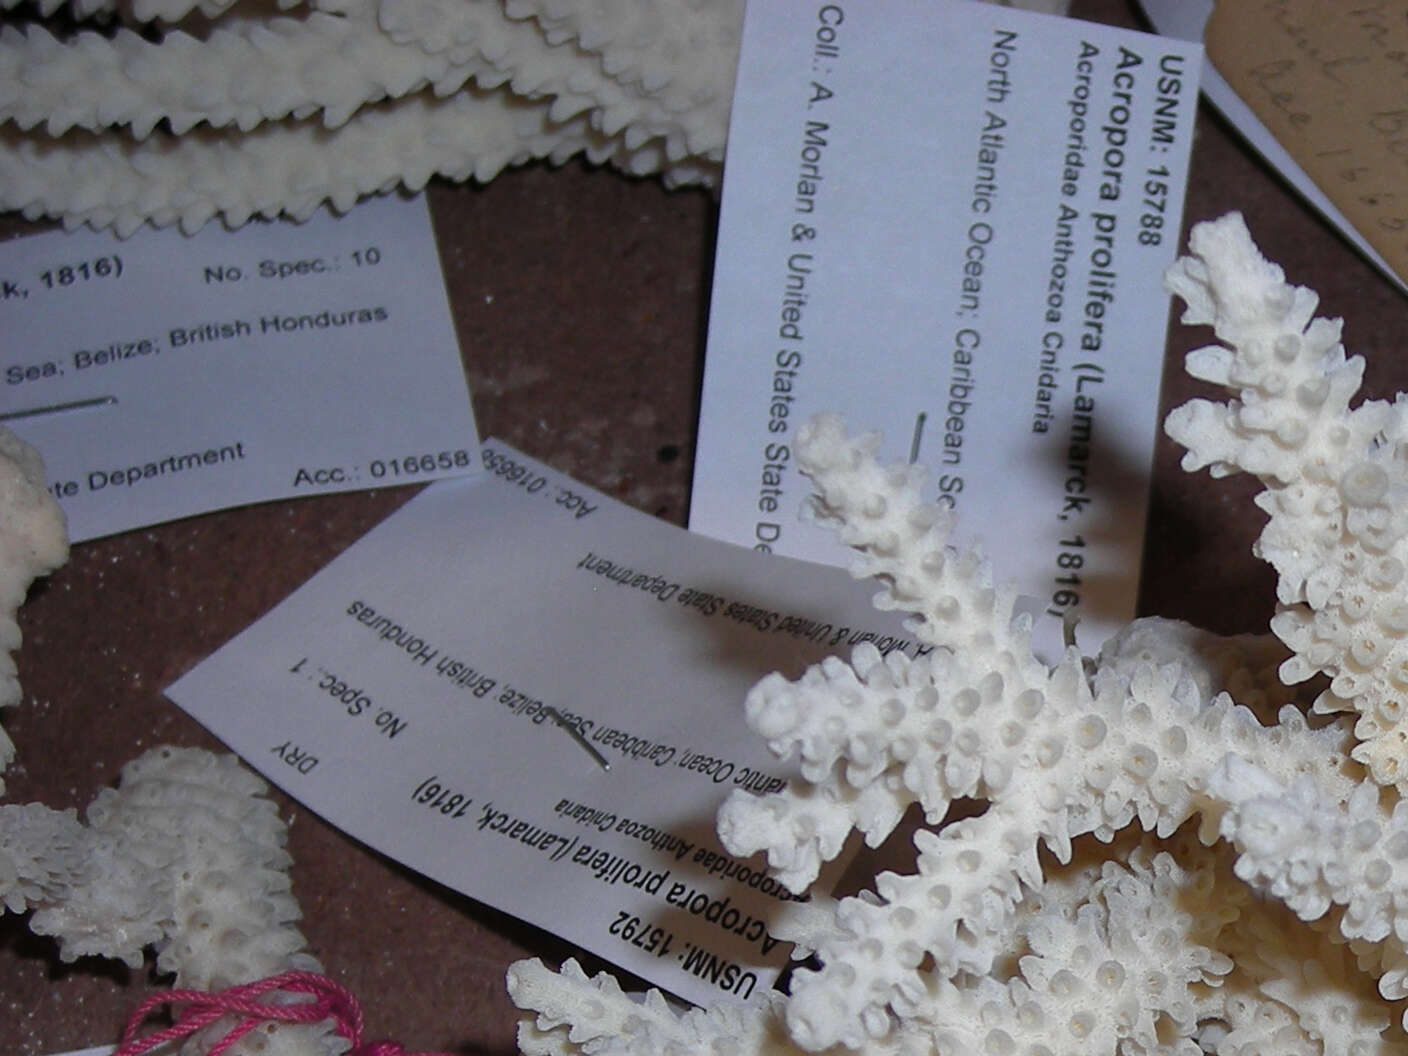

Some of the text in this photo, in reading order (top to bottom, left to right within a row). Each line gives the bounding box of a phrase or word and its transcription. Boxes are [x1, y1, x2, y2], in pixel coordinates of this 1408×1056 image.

[987, 29, 1017, 102] North
[1099, 46, 1143, 201] Acropora
[1138, 54, 1184, 246] USNM: 15788
[796, 120, 830, 213] Morlan
[971, 110, 1007, 214] Atlantic
[791, 222, 816, 242] &
[1033, 41, 1099, 434] Acroporidae Anthozoa Cnidaria
[41, 255, 124, 289] 1816)
[204, 265, 249, 284] No.
[351, 247, 381, 267] 10
[779, 253, 813, 340] United
[955, 221, 993, 319] Ocean;
[1081, 212, 1118, 353] prolifera
[6, 306, 389, 386] Sea; Belize; British Honduras
[768, 350, 801, 434] States
[941, 328, 980, 465] Caribbean
[88, 442, 246, 491] Department
[370, 451, 470, 479] 016658
[1057, 363, 1104, 521] (Lamarck,
[759, 443, 790, 513] State
[576, 551, 681, 601] Department
[678, 588, 725, 616] State
[346, 600, 438, 666] Honduras
[723, 601, 778, 632] States
[775, 616, 833, 643] United
[830, 627, 849, 645] &
[289, 657, 308, 674] 1
[436, 656, 497, 698] British
[271, 741, 319, 775] DRY
[592, 725, 677, 766] Caribbean
[676, 748, 734, 784] Ocean;
[412, 776, 472, 818] 1816)
[477, 800, 580, 865] (Lamarck,
[554, 799, 811, 902] croporidae Anthozoa Cnidaria
[572, 846, 670, 896] prolifera
[608, 911, 757, 1000] USNM: 15792
